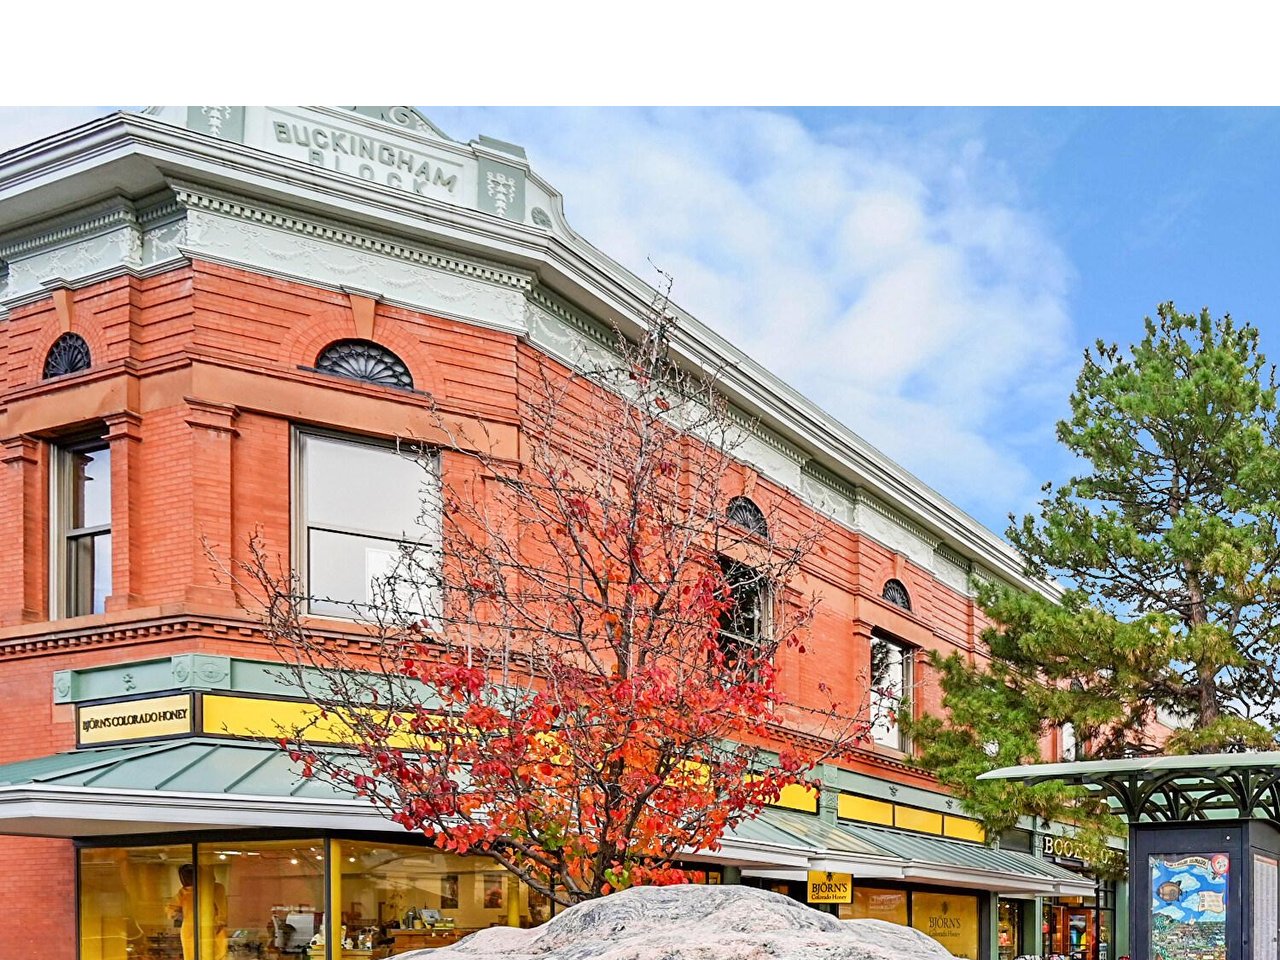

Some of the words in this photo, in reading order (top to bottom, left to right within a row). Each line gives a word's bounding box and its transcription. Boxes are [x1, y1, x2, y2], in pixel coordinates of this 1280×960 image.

[273, 120, 457, 193] BUCKINGHAM
[111, 712, 158, 727] COLORADO
[158, 708, 188, 722] HONEY
[812, 882, 847, 894] BJÖRN'S
